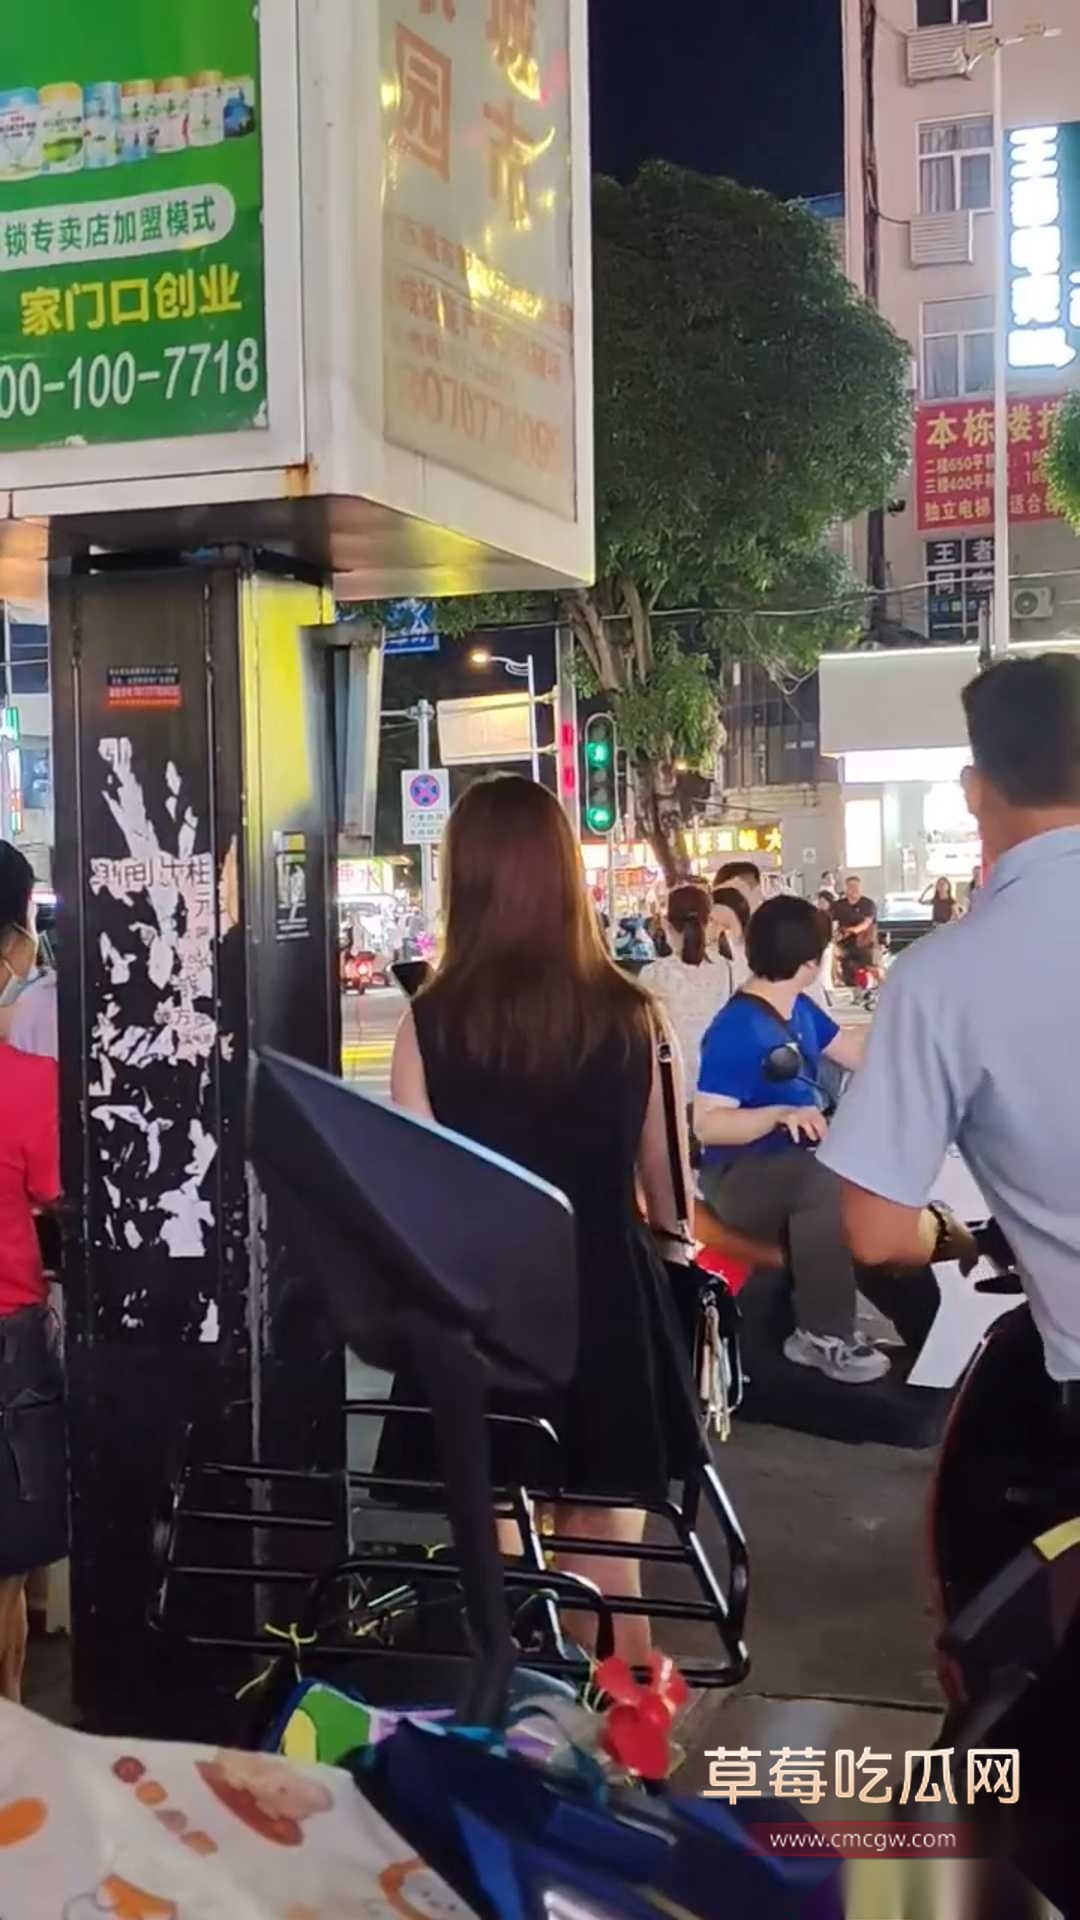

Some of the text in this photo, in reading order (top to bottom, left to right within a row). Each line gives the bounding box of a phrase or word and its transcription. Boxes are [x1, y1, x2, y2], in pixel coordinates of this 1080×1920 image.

[4, 196, 217, 258] 锁专卖店加盟模式
[20, 263, 243, 336] 家门口创业
[0, 337, 258, 419] 00-100-7718
